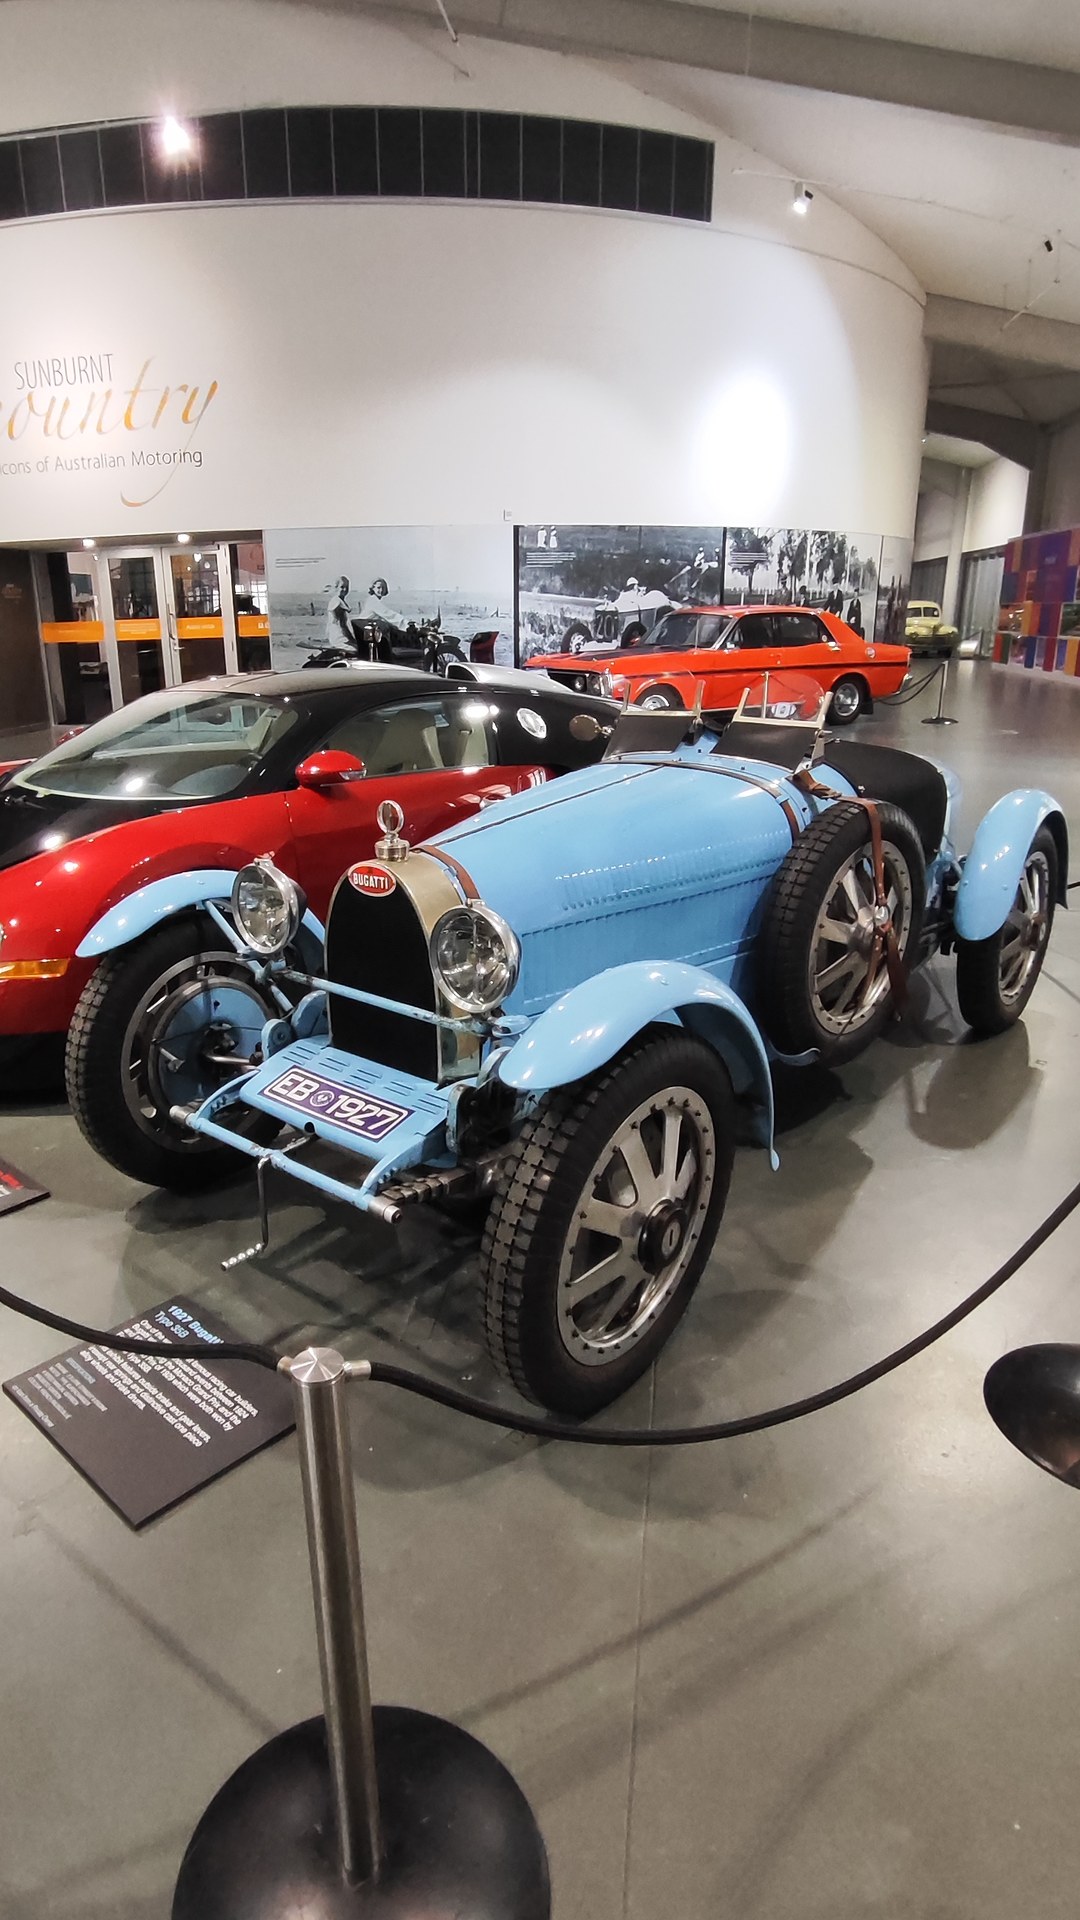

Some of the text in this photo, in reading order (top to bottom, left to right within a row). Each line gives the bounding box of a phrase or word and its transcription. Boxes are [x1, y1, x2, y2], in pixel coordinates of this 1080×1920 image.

[14, 353, 113, 390] SUNBURNT
[0, 356, 218, 507] ountry
[36, 455, 49, 473] of
[54, 453, 125, 471] Australian
[131, 448, 203, 468] Motoring
[353, 872, 388, 890] BUGATTI
[272, 1074, 319, 1101] EB
[326, 1094, 400, 1131] 1927
[168, 1305, 224, 1344] 1927 Bugatt
